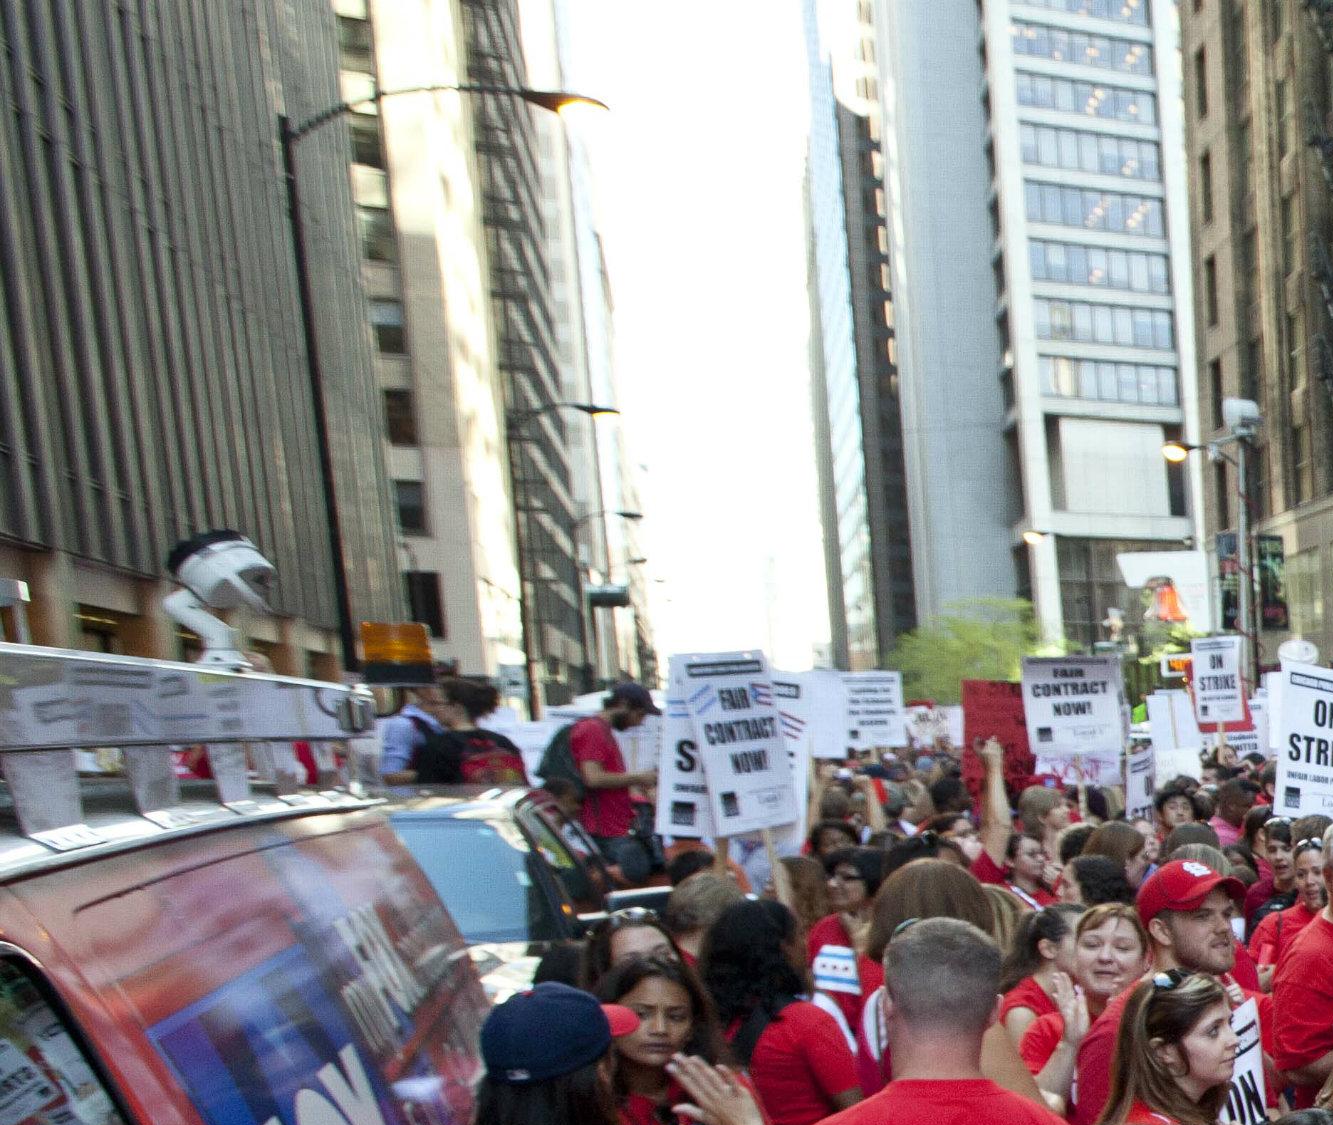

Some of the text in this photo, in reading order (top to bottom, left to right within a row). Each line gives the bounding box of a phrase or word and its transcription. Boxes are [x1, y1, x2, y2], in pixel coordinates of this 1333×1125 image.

[1209, 653, 1224, 670] ON
[1053, 667, 1085, 679] FAIR
[1031, 681, 1109, 699] CONTRACT
[1199, 674, 1237, 692] STRIKE
[718, 686, 751, 711] FAIR
[1053, 701, 1093, 717] NOW!
[704, 717, 778, 746] CONTRACT
